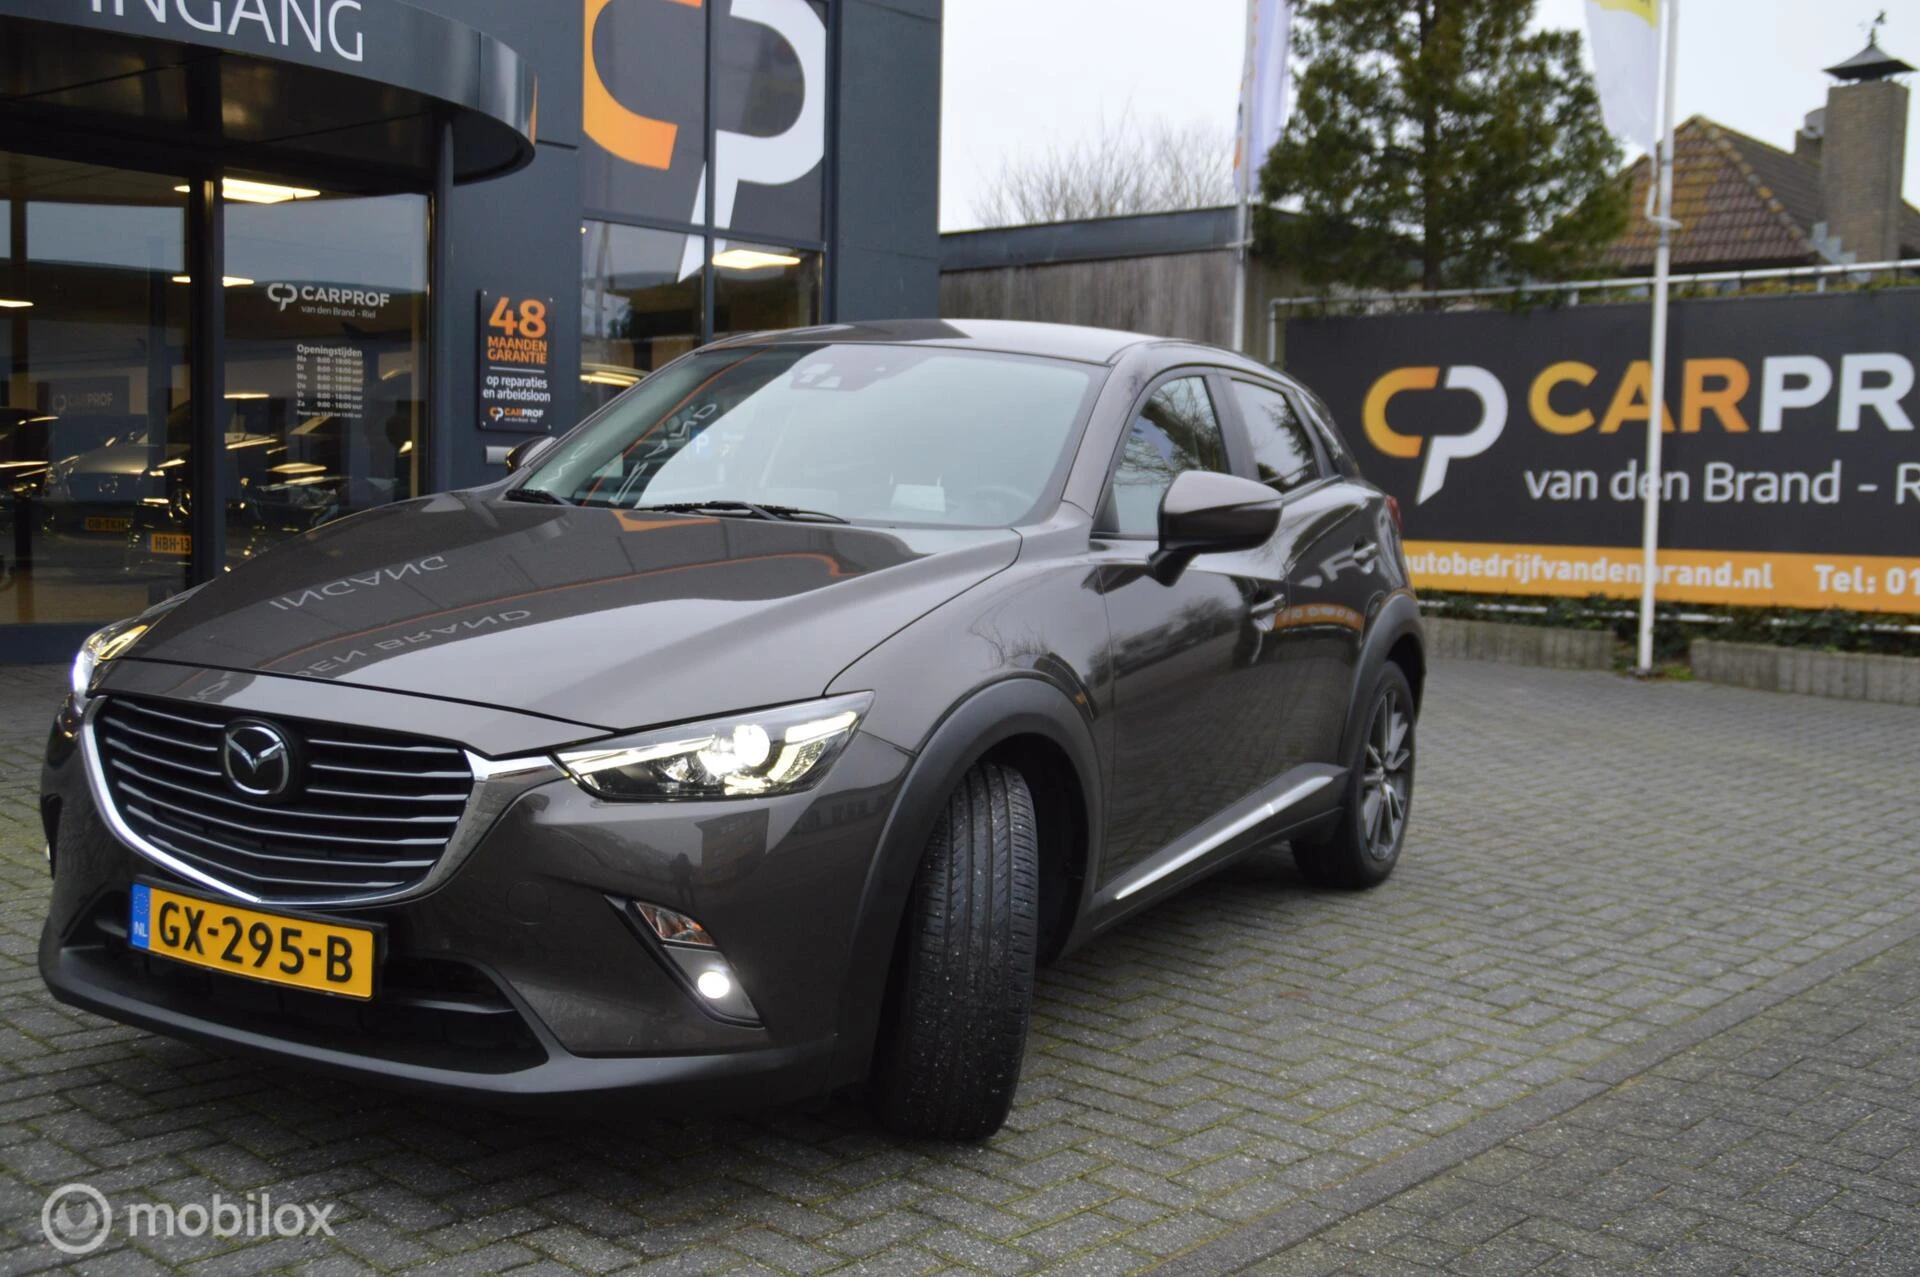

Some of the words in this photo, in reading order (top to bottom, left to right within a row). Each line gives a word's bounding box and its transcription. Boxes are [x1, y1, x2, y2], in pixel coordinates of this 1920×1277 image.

[92, 0, 363, 62] GANG
[301, 286, 390, 308] CARPROF
[301, 305, 315, 314] van
[317, 305, 332, 316] den
[333, 306, 355, 317] Brand
[489, 296, 546, 338] 48
[297, 344, 362, 358] Openingstijden
[487, 336, 547, 353] MAANDEN
[487, 348, 547, 364] GARANTIE
[486, 376, 499, 388] op
[501, 376, 548, 389] reparaties
[483, 389, 495, 399] en
[497, 387, 551, 402] arbeidsloon
[1527, 353, 1915, 435] CARPR
[504, 407, 544, 418] CARPROF
[1524, 470, 1599, 501] van
[1609, 458, 1690, 502] den
[1704, 459, 1842, 504] Brand
[1404, 551, 1775, 589] utobedrijfvandenrand.nl
[1813, 564, 1877, 593] Tel:
[134, 921, 148, 938] NL
[158, 901, 353, 983] GX-295-B
